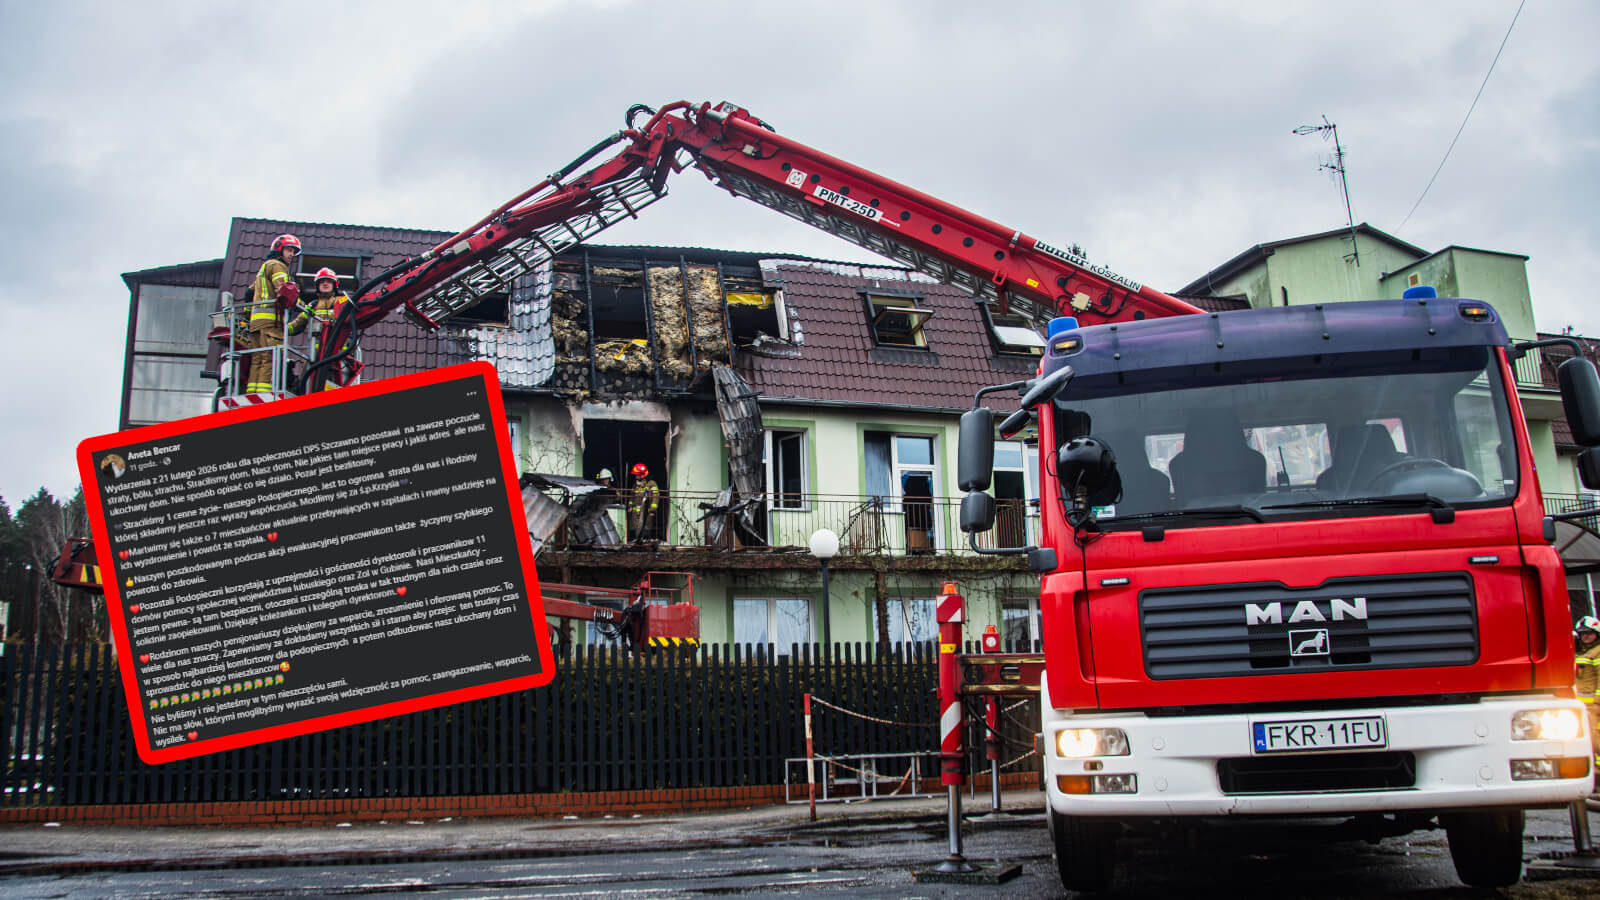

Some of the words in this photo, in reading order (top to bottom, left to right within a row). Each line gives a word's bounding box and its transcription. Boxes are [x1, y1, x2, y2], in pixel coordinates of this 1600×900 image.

[819, 188, 877, 219] PMT-25D
[1090, 263, 1141, 291] KOSZALIN
[1245, 597, 1368, 625] MAN
[1268, 725, 1317, 748] FKR
[1328, 721, 1381, 745] 11FU
